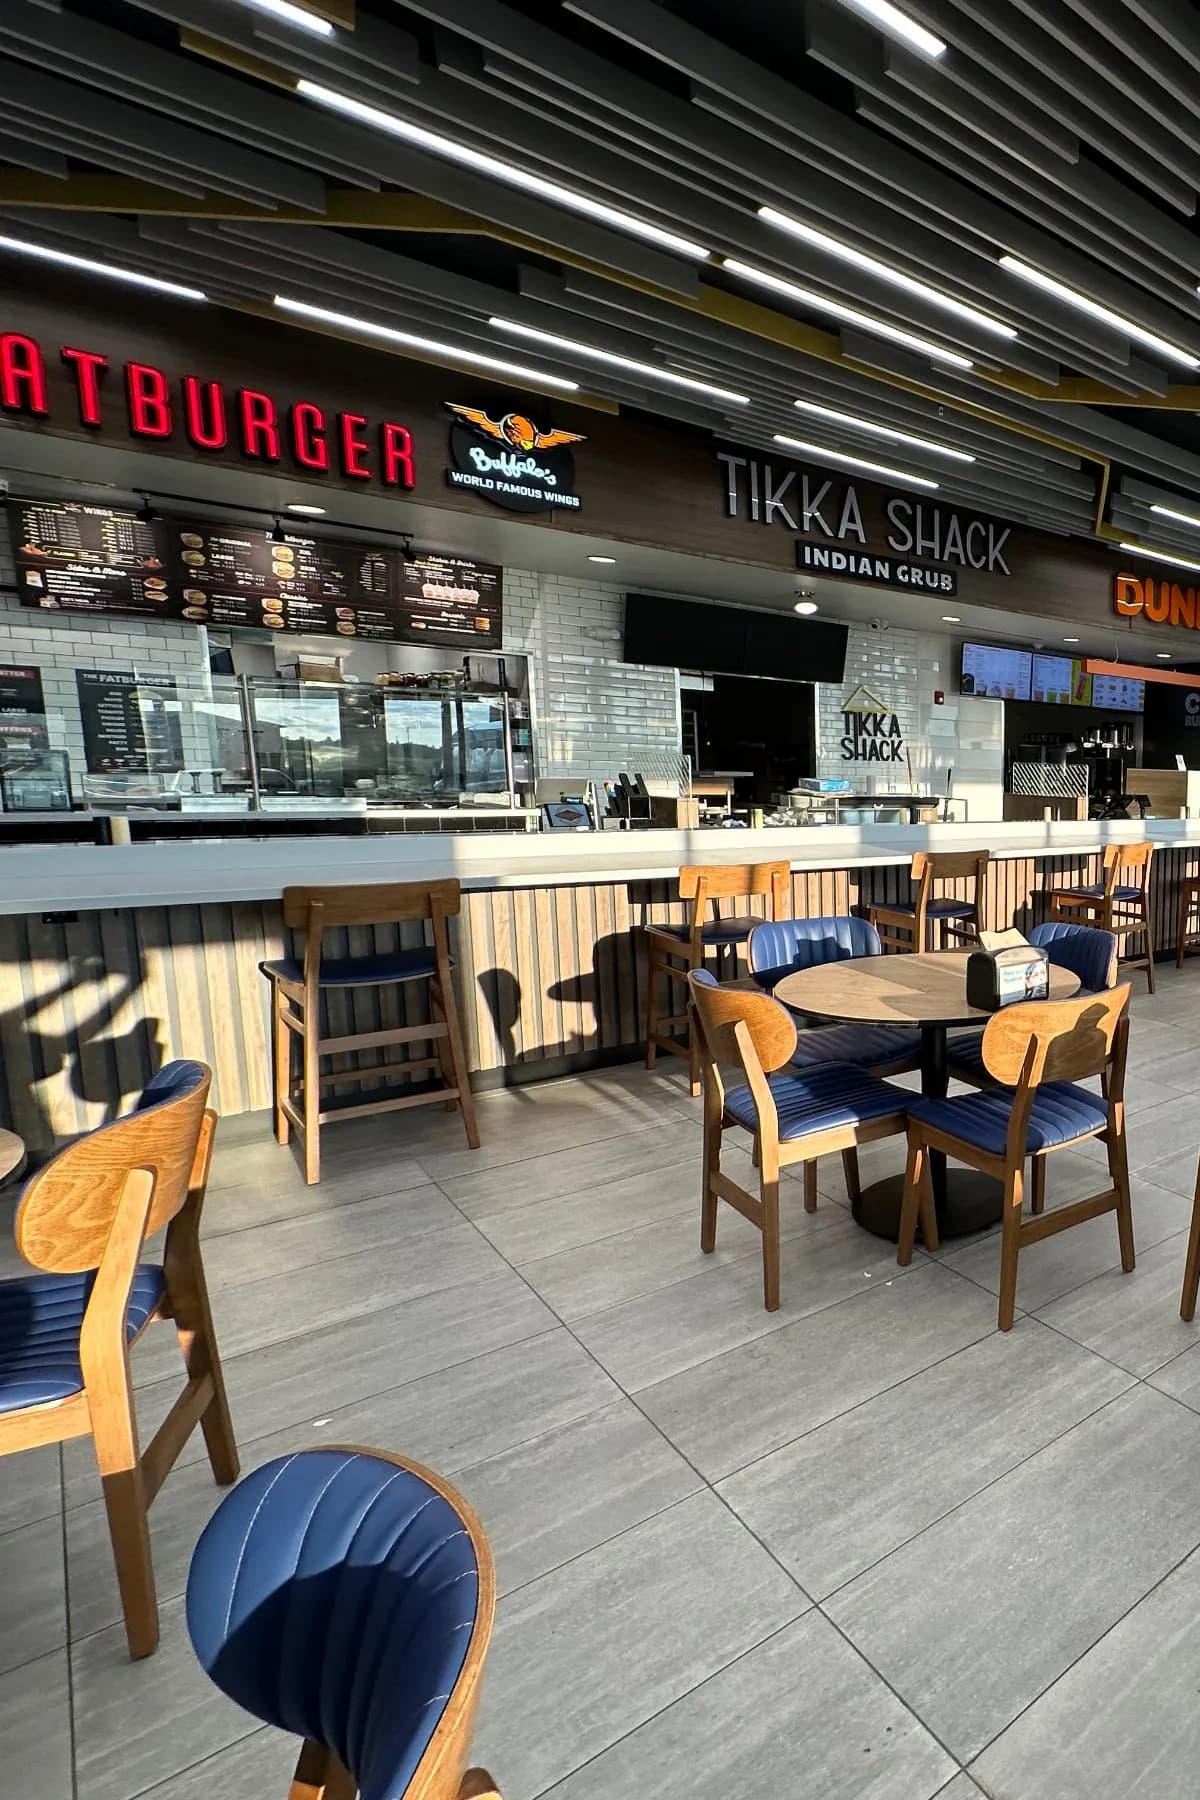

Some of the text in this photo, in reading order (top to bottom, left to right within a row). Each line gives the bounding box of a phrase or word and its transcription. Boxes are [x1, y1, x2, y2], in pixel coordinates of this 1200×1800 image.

[469, 447, 556, 485] Buffalo's
[451, 471, 580, 507] WORLD FAMOUS WINGS
[717, 452, 1012, 575] TIKKA SHACK
[804, 546, 953, 591] INDIAN GRUB
[840, 711, 902, 738] TIKKA
[841, 737, 904, 762] SHACK
